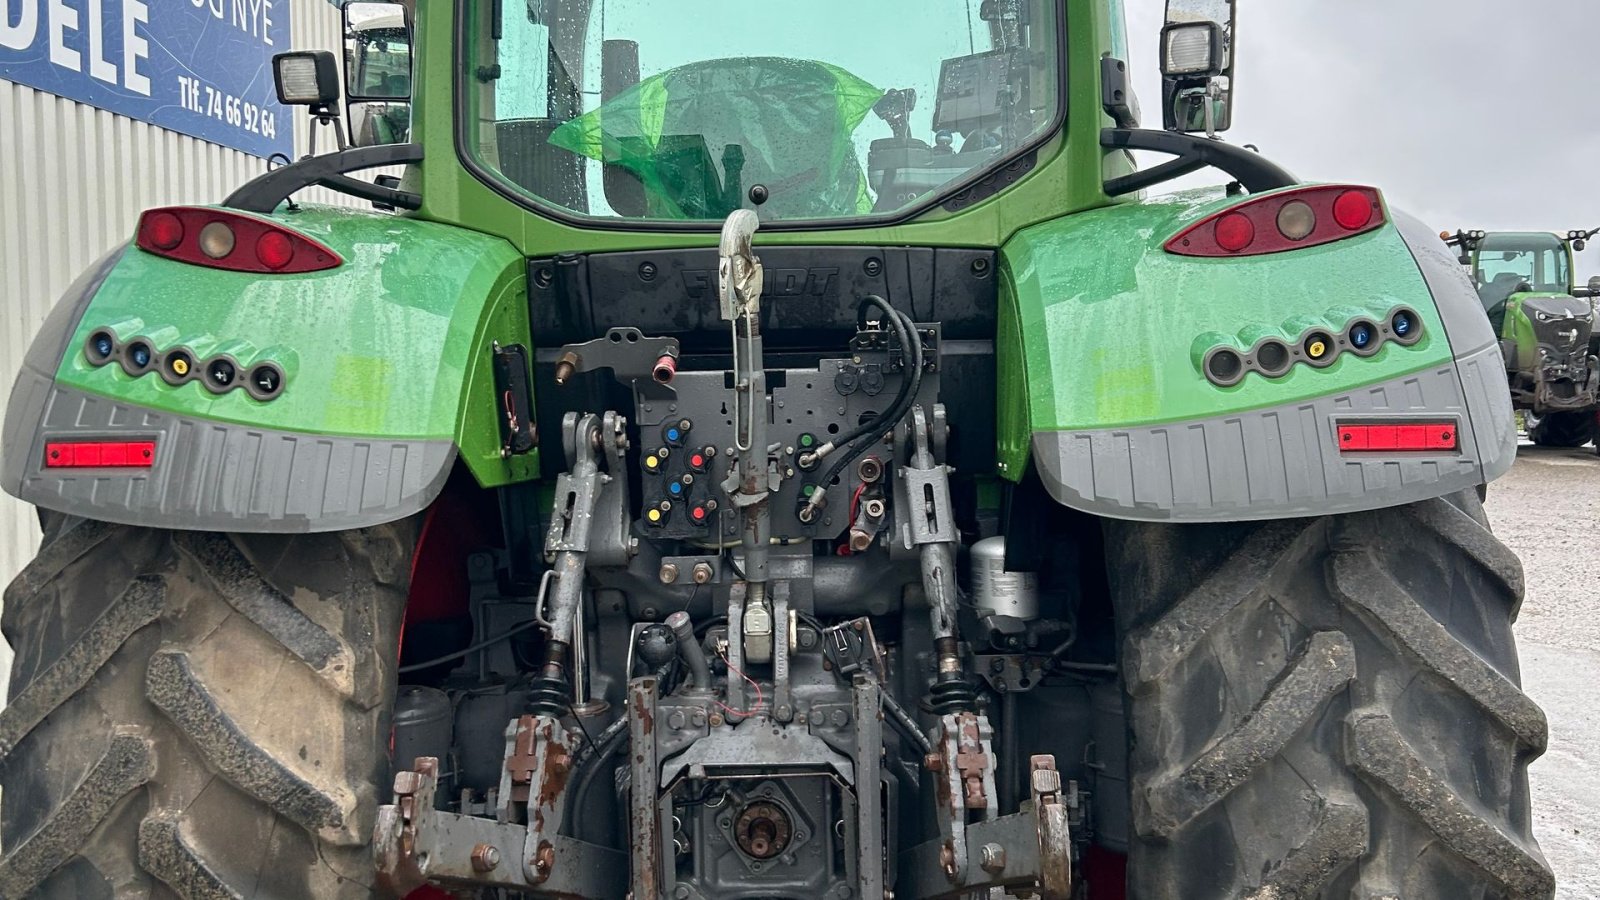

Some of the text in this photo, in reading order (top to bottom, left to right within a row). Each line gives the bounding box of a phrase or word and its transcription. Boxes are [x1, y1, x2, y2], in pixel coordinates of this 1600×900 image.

[232, 0, 273, 46] NYE
[178, 75, 275, 139] Tlf. 74 66 92 64
[681, 266, 840, 298] FDT
